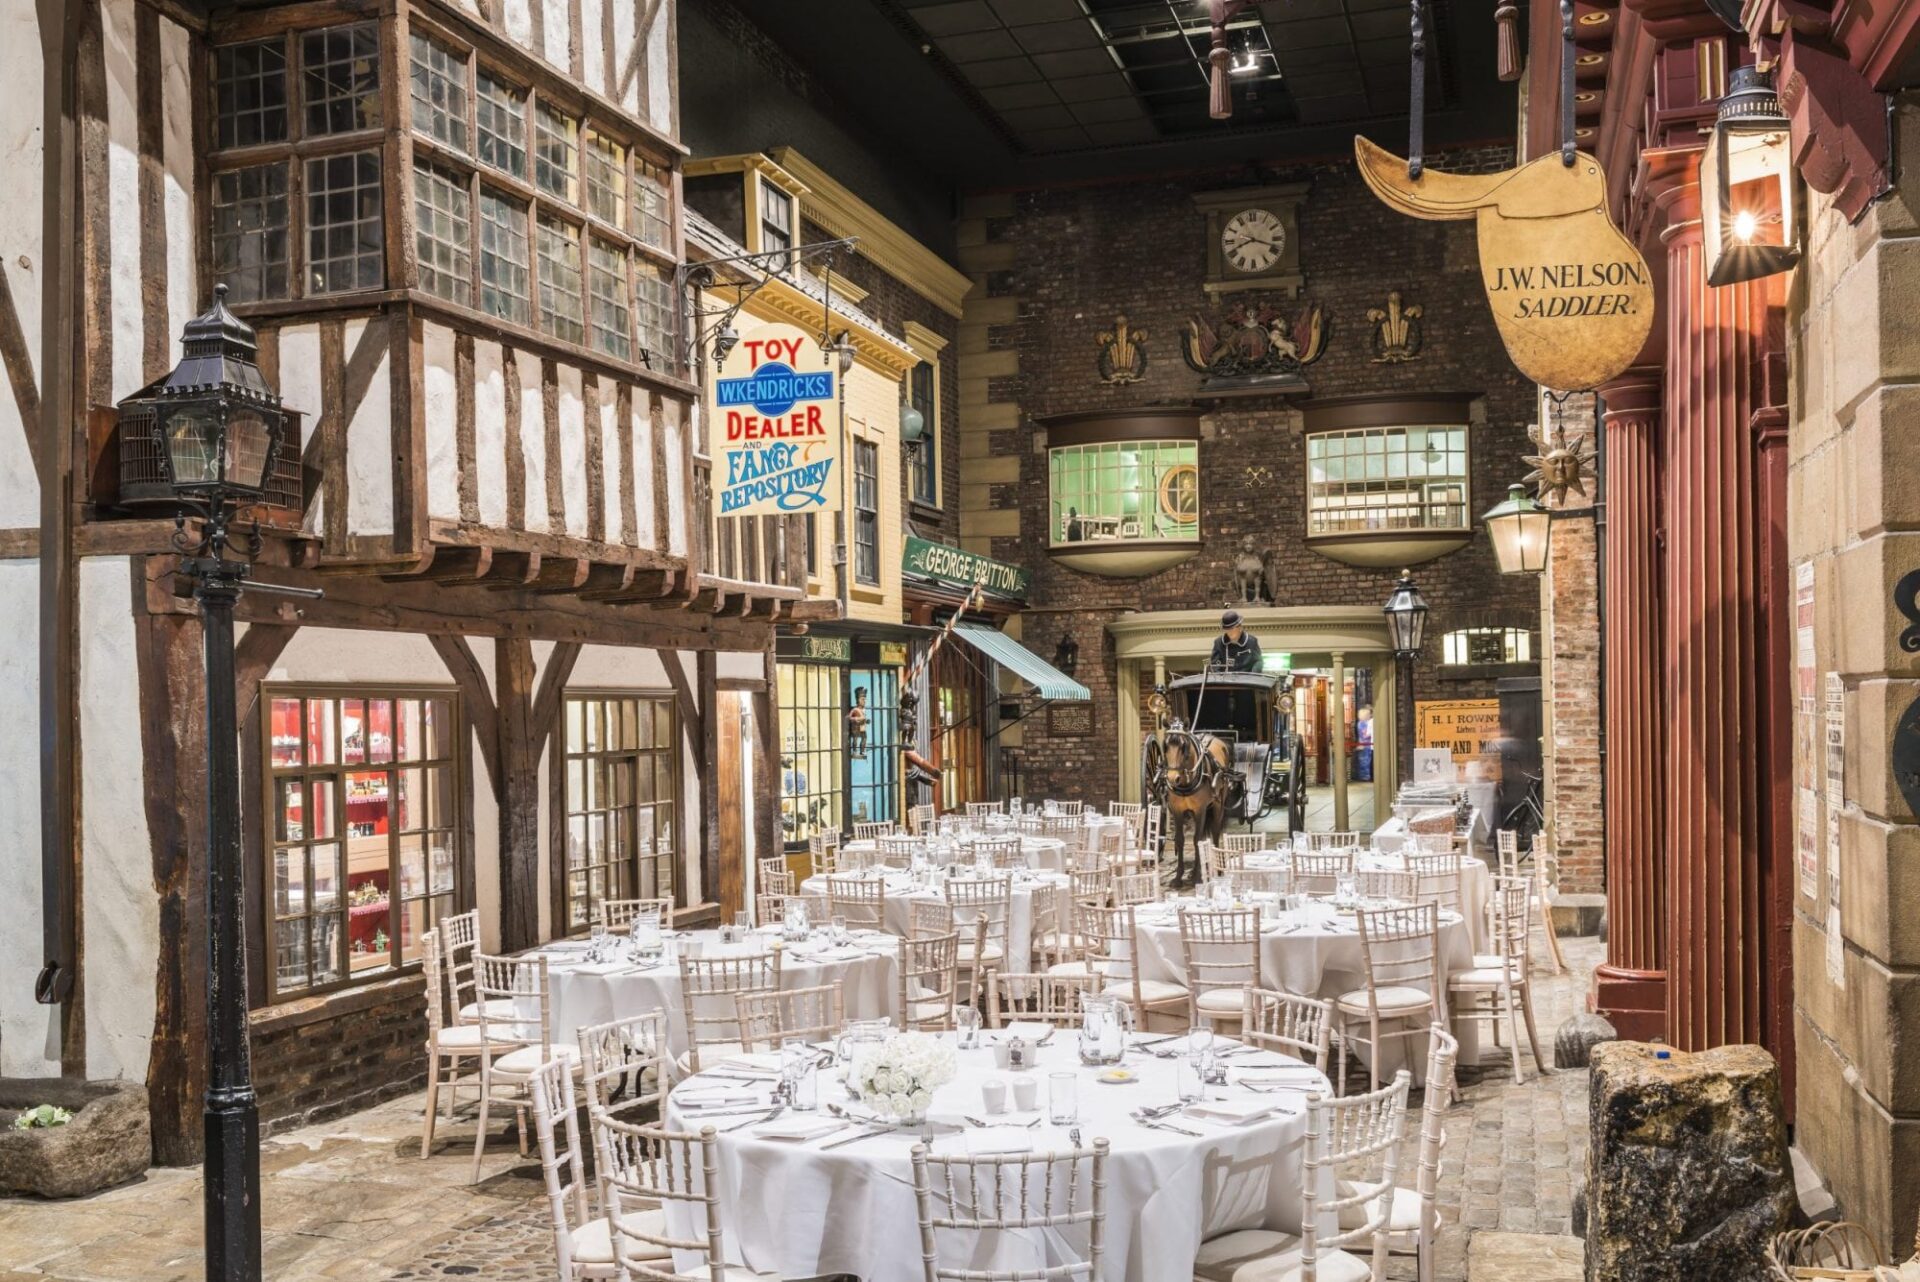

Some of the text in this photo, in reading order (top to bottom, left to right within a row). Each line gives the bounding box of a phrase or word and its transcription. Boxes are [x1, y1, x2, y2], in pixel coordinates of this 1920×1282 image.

[1541, 261, 1647, 289] NELSON.
[1514, 294, 1637, 319] SADDLER.
[743, 337, 805, 371] TOY
[727, 405, 826, 440] DEALER
[727, 442, 799, 486] FANCY
[720, 457, 834, 513] REPOSITORY
[926, 546, 1017, 591] GEORGE BRITTON
